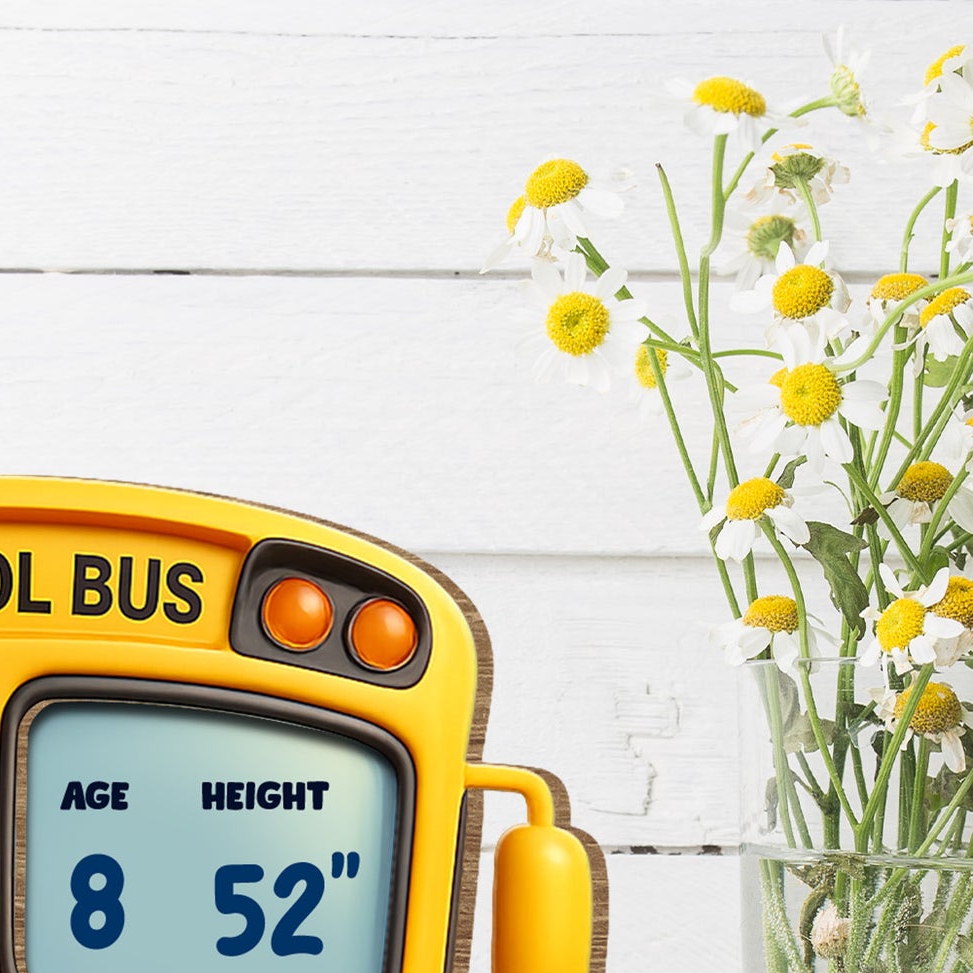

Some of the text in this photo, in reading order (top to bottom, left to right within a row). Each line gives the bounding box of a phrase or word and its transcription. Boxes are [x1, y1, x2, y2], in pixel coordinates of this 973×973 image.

[71, 553, 205, 625] BUS
[59, 780, 130, 811] AGE
[201, 780, 330, 811] HEIGHT
[68, 853, 126, 951] 8
[213, 851, 361, 957] 52"
